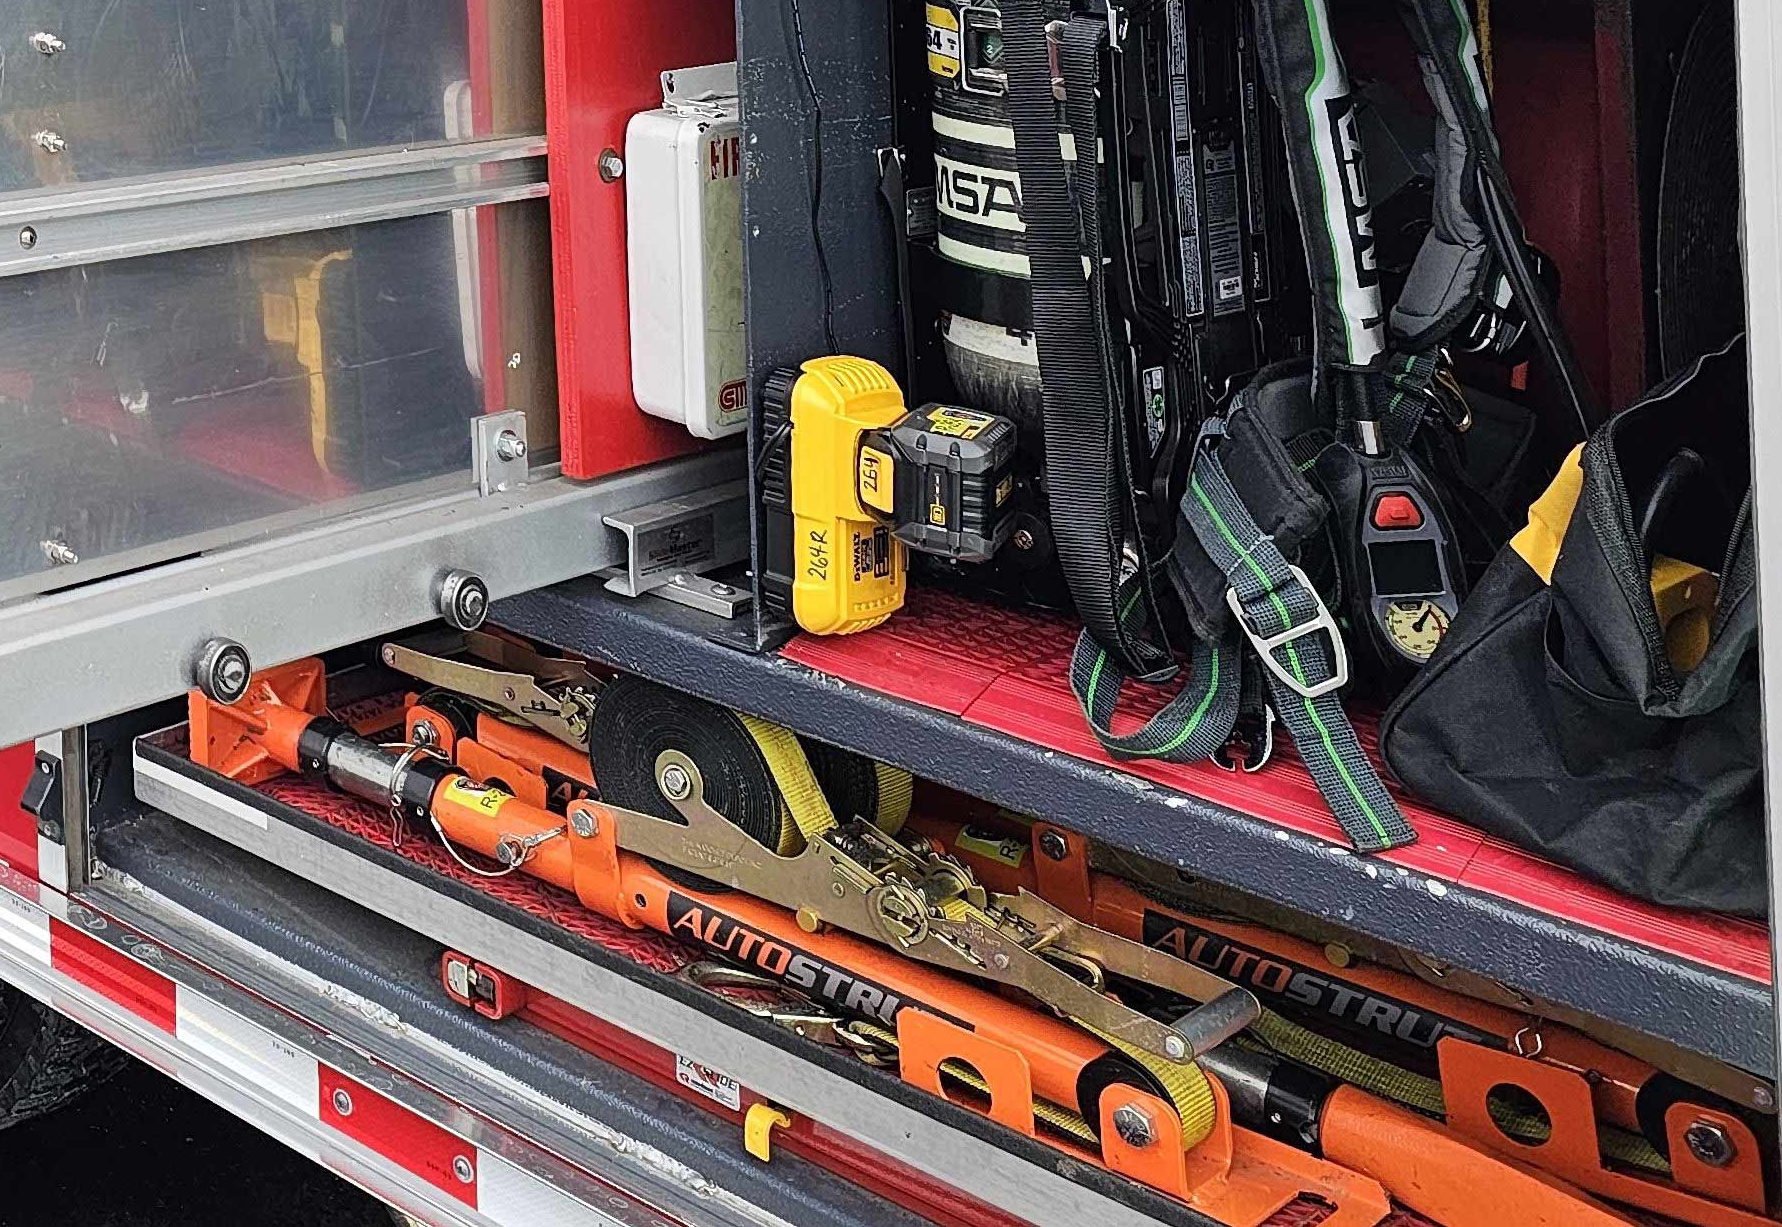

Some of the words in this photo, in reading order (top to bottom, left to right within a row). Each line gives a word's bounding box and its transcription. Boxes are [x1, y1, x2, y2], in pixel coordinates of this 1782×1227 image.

[937, 165, 1023, 218] MSA
[863, 457, 879, 493] 264
[807, 529, 829, 581] 264R
[673, 906, 902, 1027] AUTOSTR
